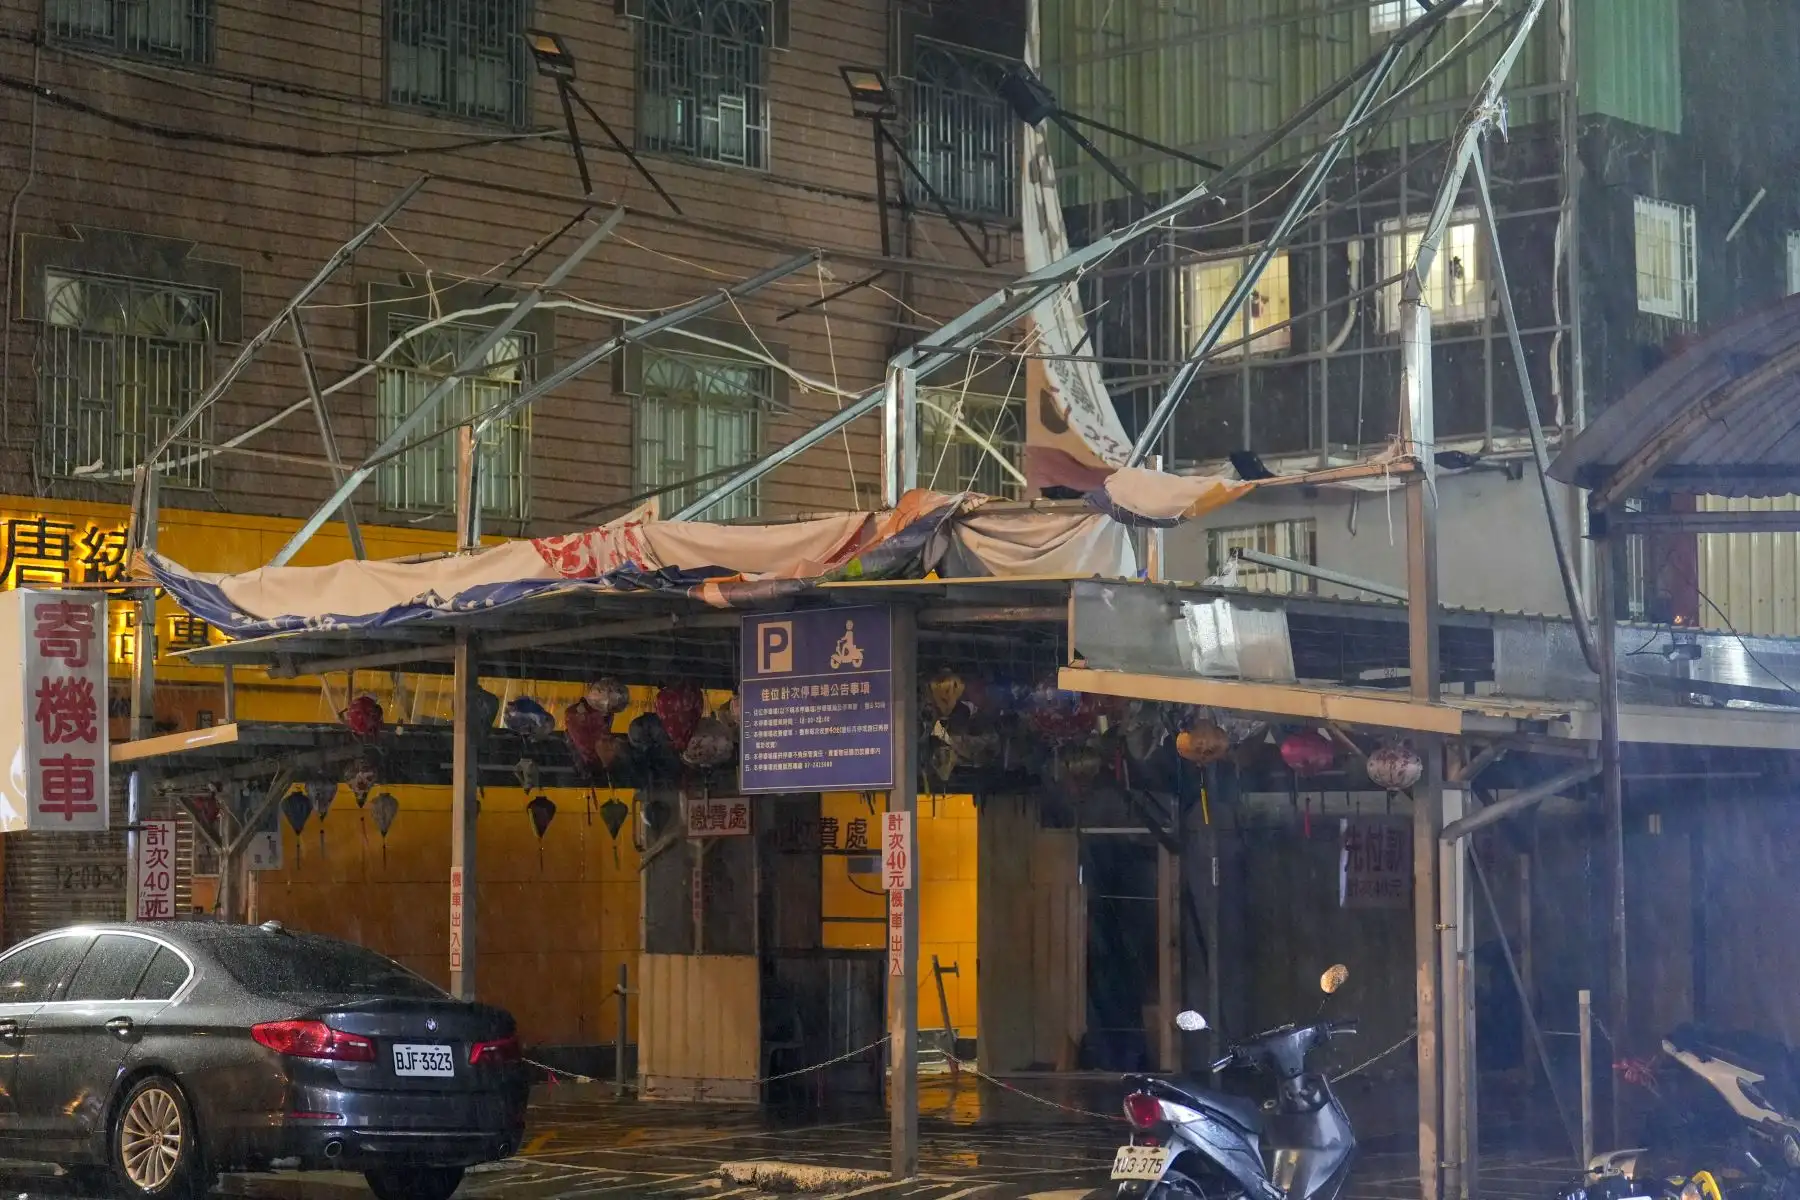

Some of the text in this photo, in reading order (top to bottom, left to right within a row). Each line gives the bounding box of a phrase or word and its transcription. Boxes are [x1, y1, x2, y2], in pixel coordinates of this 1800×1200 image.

[763, 627, 789, 669] P
[34, 599, 98, 821] 寄機車
[886, 814, 906, 888] 計次40元
[451, 871, 462, 967] 機車出入口
[890, 889, 904, 975] 機車出入
[395, 1051, 453, 1071] BJF-3323
